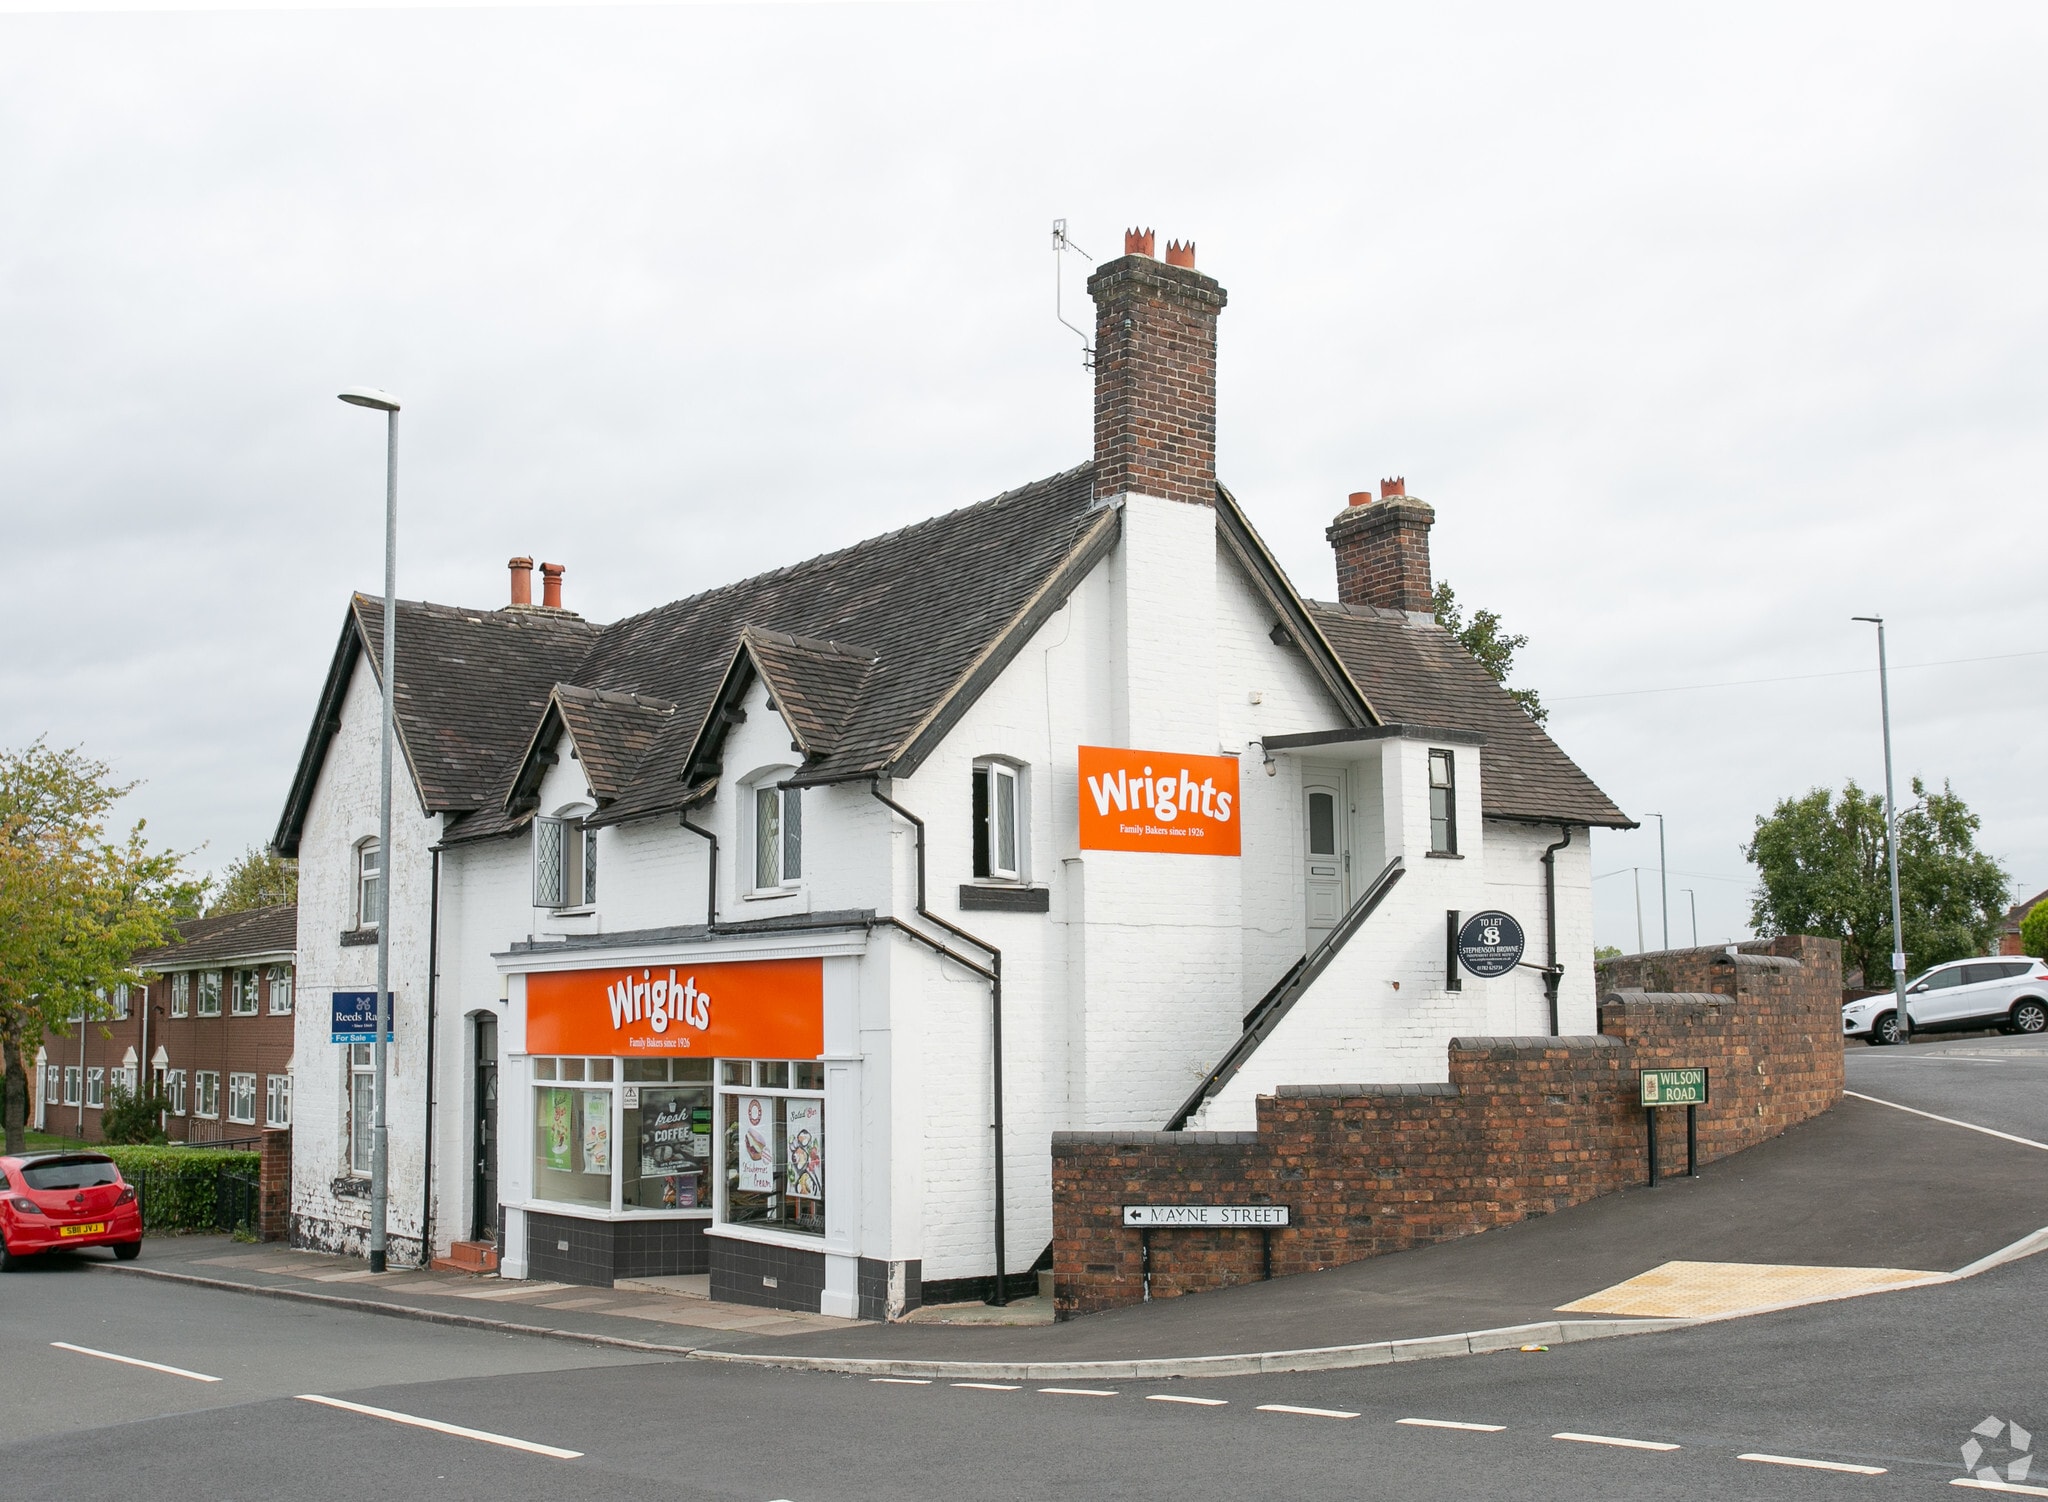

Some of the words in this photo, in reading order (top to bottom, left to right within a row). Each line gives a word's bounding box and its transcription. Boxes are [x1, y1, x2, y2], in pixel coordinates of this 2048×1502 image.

[1087, 765, 1232, 822] Wrights
[1119, 824, 1143, 836] Family
[1145, 826, 1168, 835] Bakers
[1169, 826, 1186, 836] since
[1188, 828, 1204, 837] 1926
[1480, 918, 1489, 927] TO
[1490, 918, 1503, 926] LET
[1462, 946, 1496, 954] STEPHENSON
[607, 968, 710, 1033] Wrights
[336, 1012, 362, 1022] Reeds
[365, 1012, 390, 1021] Ras
[629, 1037, 646, 1049] Family
[646, 1037, 663, 1048] Bakers
[664, 1037, 677, 1048] since
[678, 1038, 690, 1048] 1926
[1660, 1071, 1701, 1085] WILSON
[1666, 1088, 1696, 1101] ROAD
[654, 1108, 689, 1126] fresh
[655, 1126, 689, 1142] COFFEE
[1150, 1208, 1208, 1222] MAYNE
[1221, 1209, 1284, 1222] STREET
[66, 1226, 81, 1235] SB11
[83, 1224, 98, 1233] JVJ
